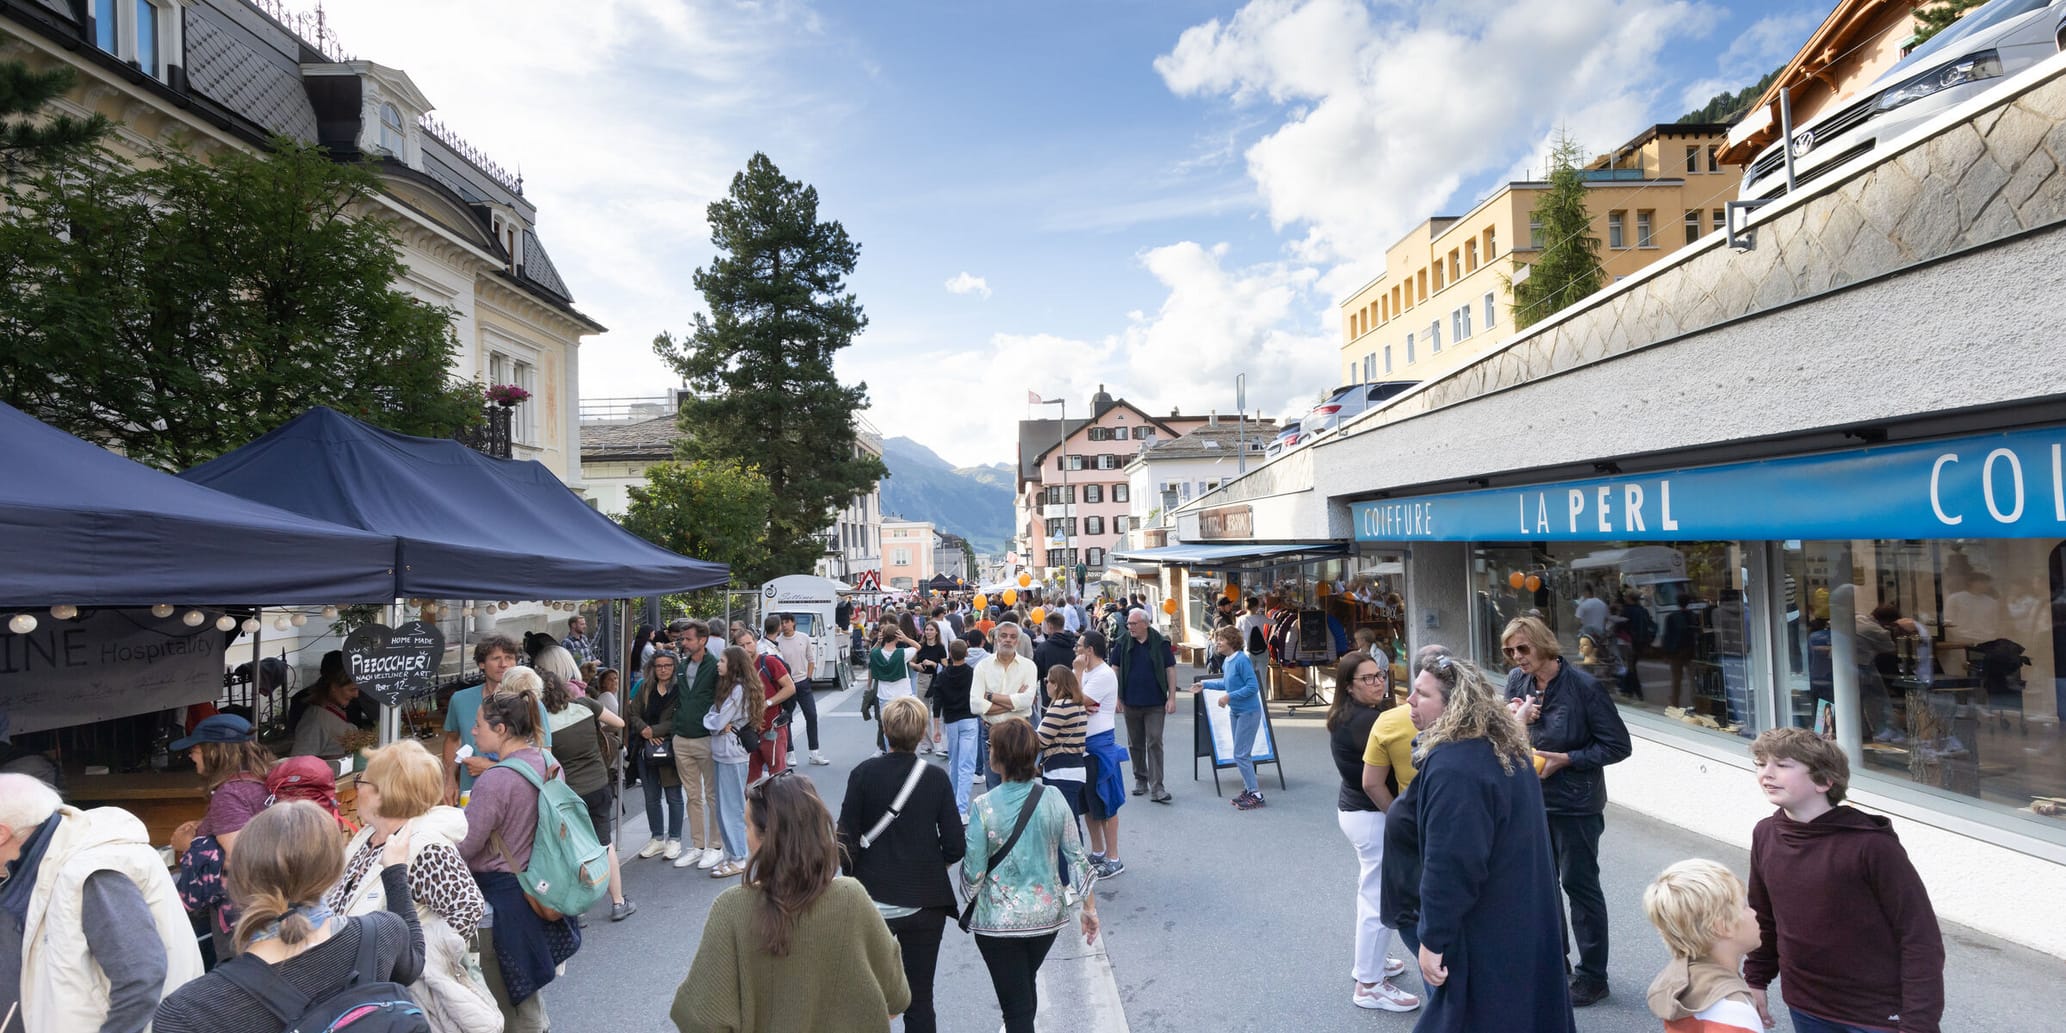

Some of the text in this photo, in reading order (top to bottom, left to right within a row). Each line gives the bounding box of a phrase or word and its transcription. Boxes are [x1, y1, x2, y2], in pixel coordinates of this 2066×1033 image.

[1930, 443, 2066, 526] COI
[1364, 480, 1678, 537] COIFFURE LA PERL
[101, 634, 216, 665] Hospitality
[391, 637, 411, 645] HOME
[413, 670, 432, 678] ART
